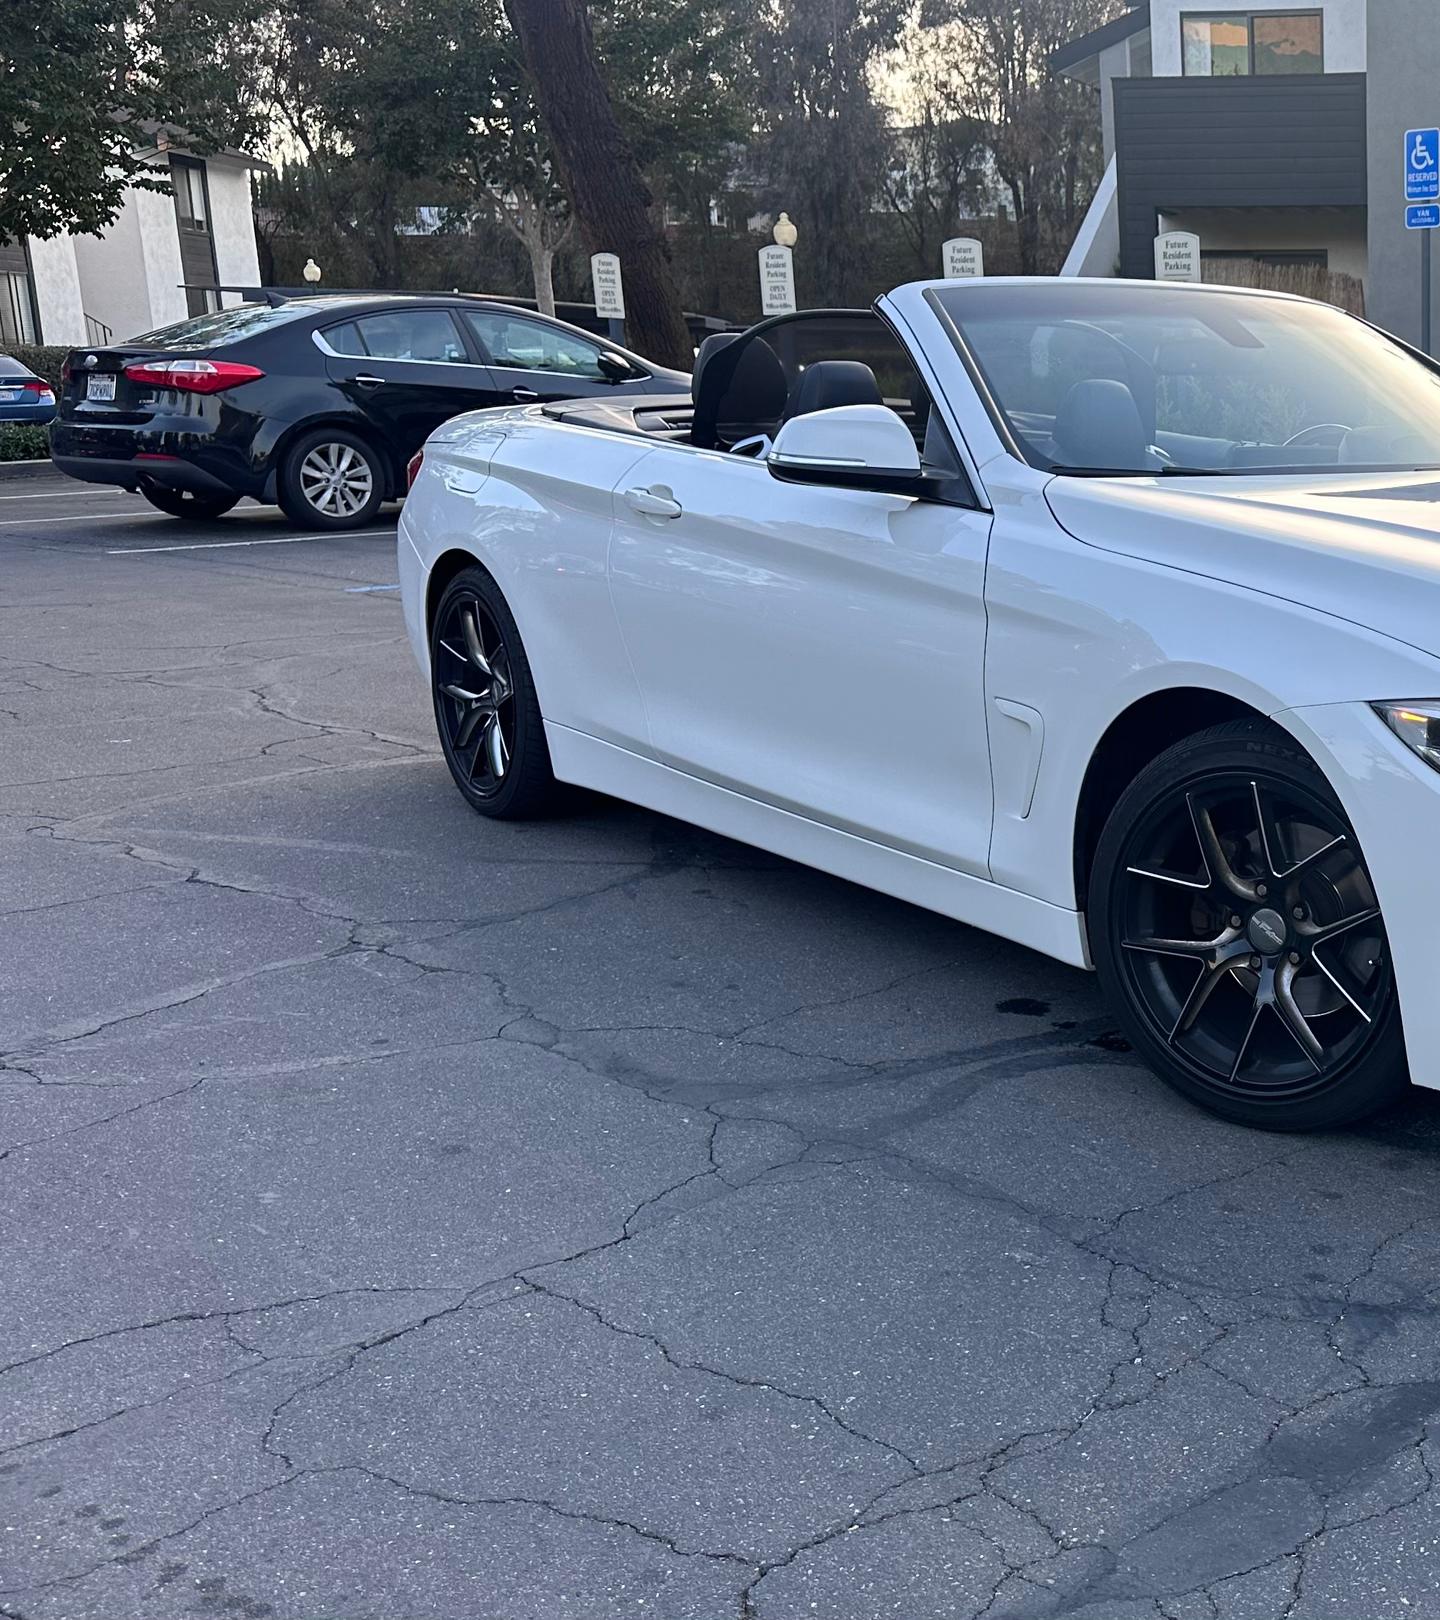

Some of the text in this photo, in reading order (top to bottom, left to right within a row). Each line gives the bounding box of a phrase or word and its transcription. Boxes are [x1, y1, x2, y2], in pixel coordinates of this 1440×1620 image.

[1407, 172, 1438, 182] RESERVED
[1416, 209, 1430, 217] VAN
[1165, 240, 1188, 249] Future
[951, 245, 972, 254] Future
[766, 252, 784, 260] Future
[950, 255, 975, 264] Resident
[1162, 250, 1192, 260] Resident
[765, 261, 787, 269] Resident
[951, 265, 975, 274] Parking
[1164, 261, 1192, 272] Parking
[766, 270, 787, 279] Parking
[598, 275, 616, 285] Parking
